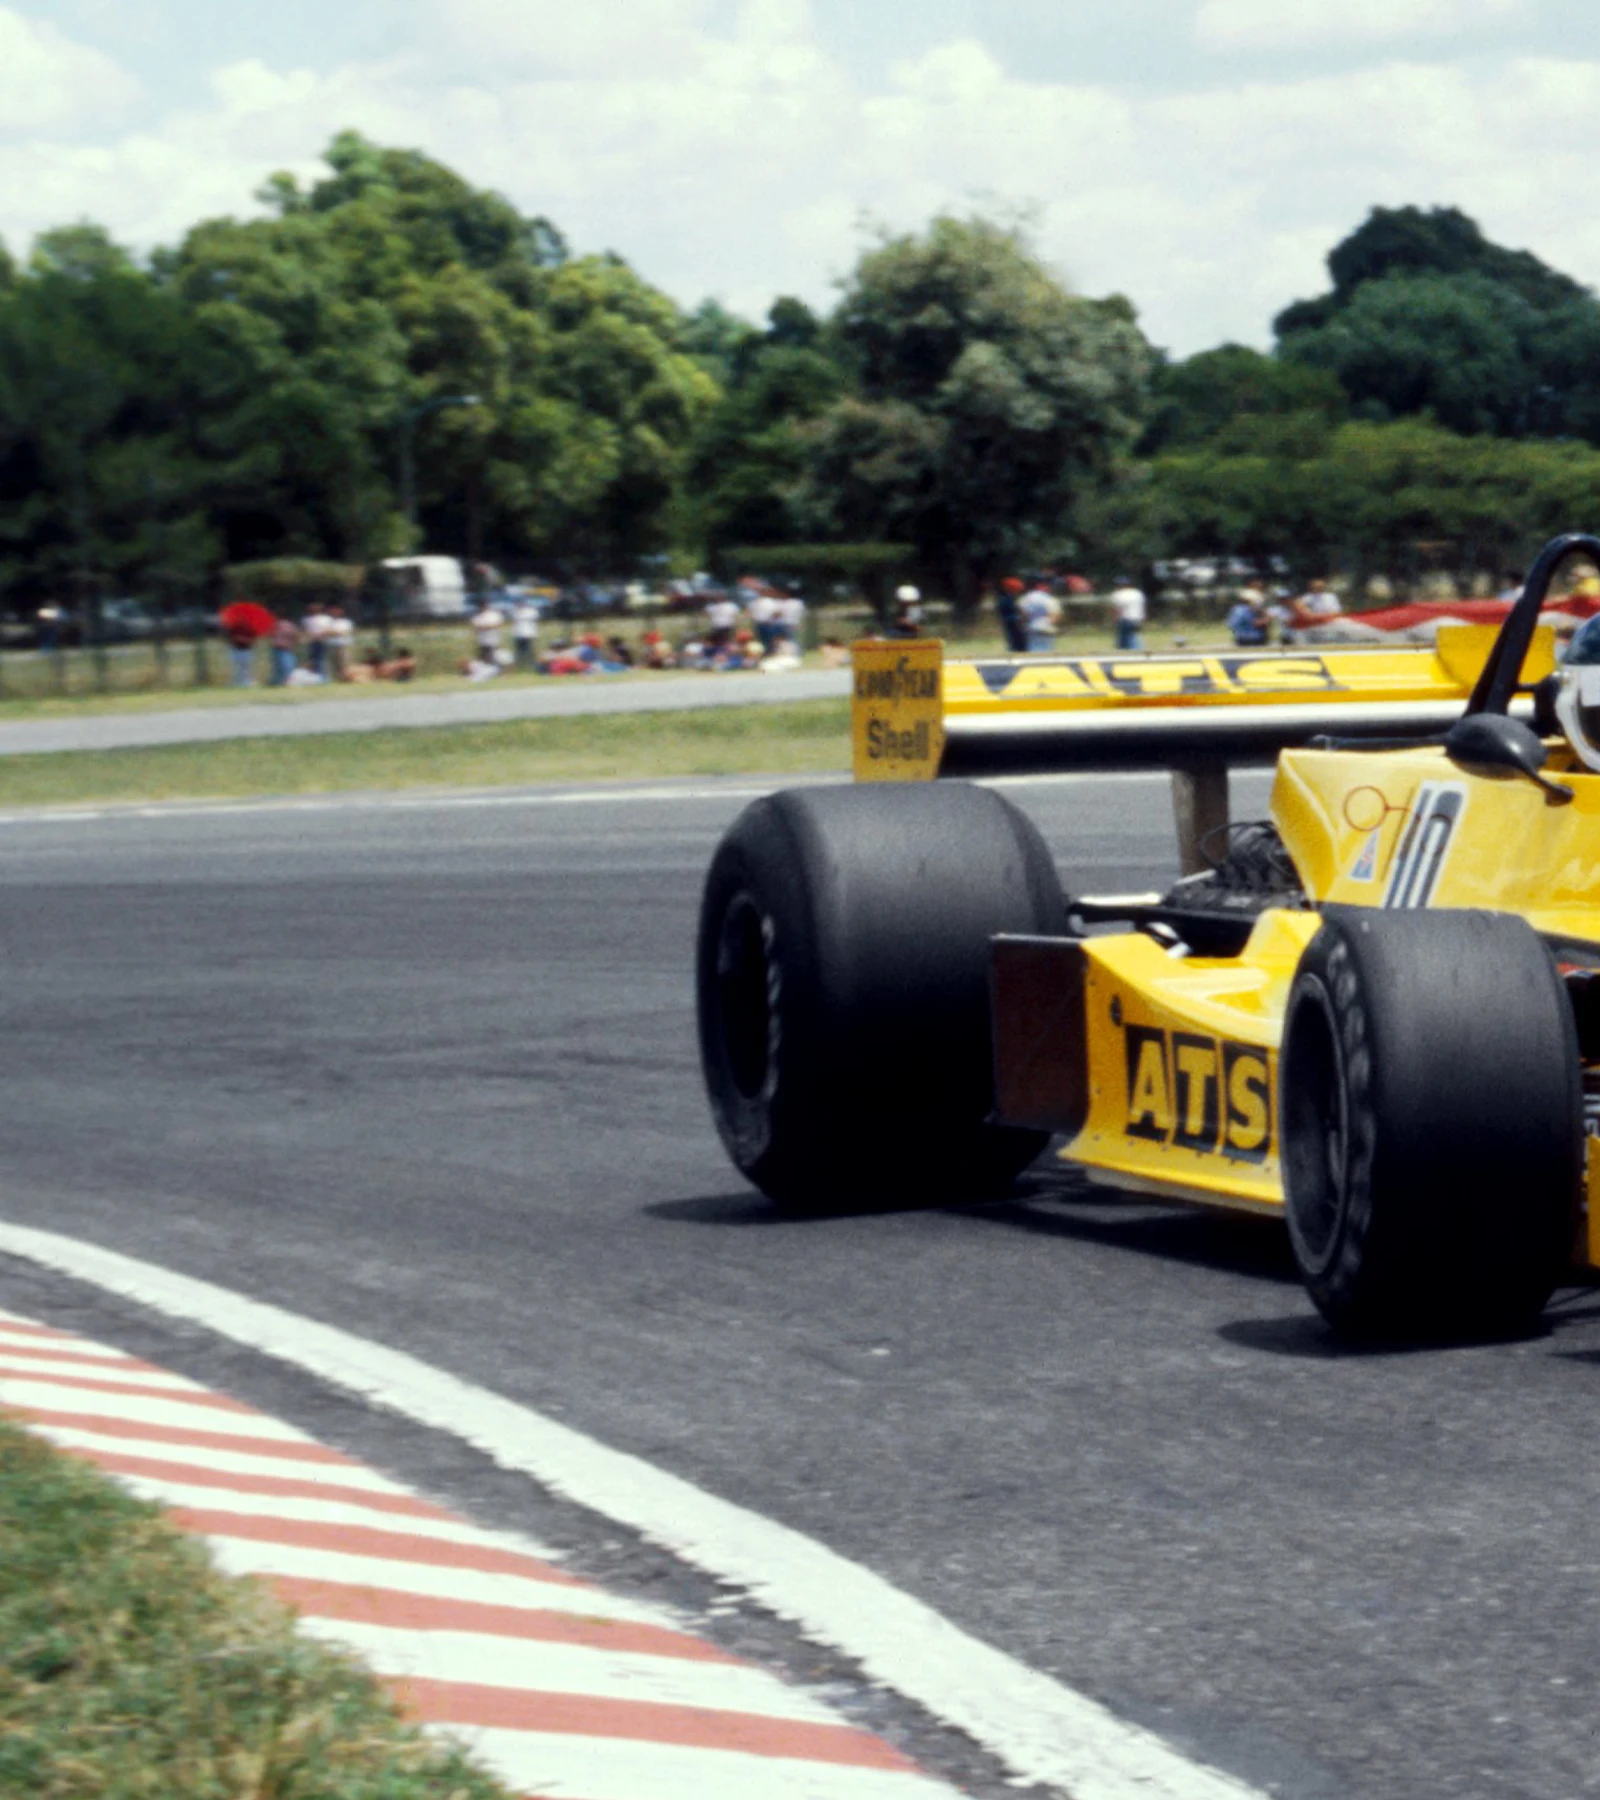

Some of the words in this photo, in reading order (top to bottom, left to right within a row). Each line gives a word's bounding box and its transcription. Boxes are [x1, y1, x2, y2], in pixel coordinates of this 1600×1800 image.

[992, 659, 1338, 697] ATS
[868, 718, 930, 760] Shell
[1129, 1036, 1269, 1151] ATS
